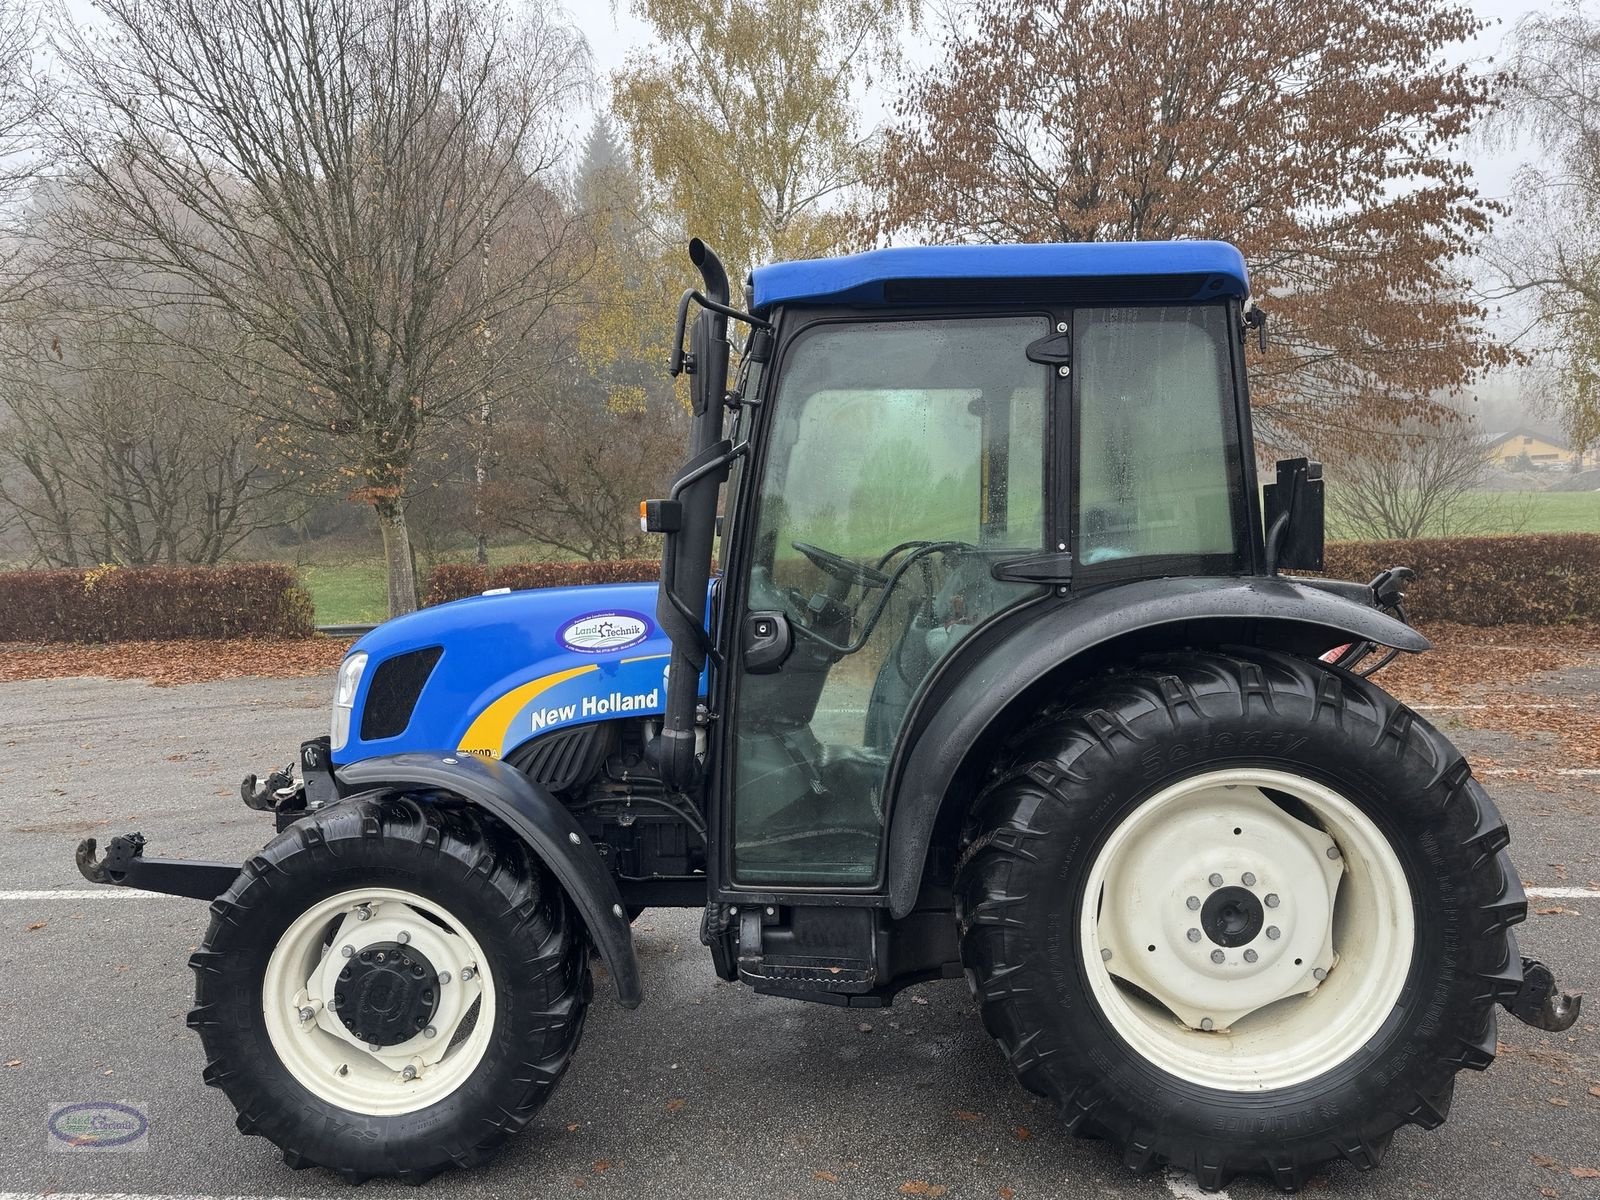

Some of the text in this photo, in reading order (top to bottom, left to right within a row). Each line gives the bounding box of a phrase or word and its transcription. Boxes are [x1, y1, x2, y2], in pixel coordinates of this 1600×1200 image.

[575, 624, 641, 637] Land Technik
[530, 688, 659, 732] New Holland
